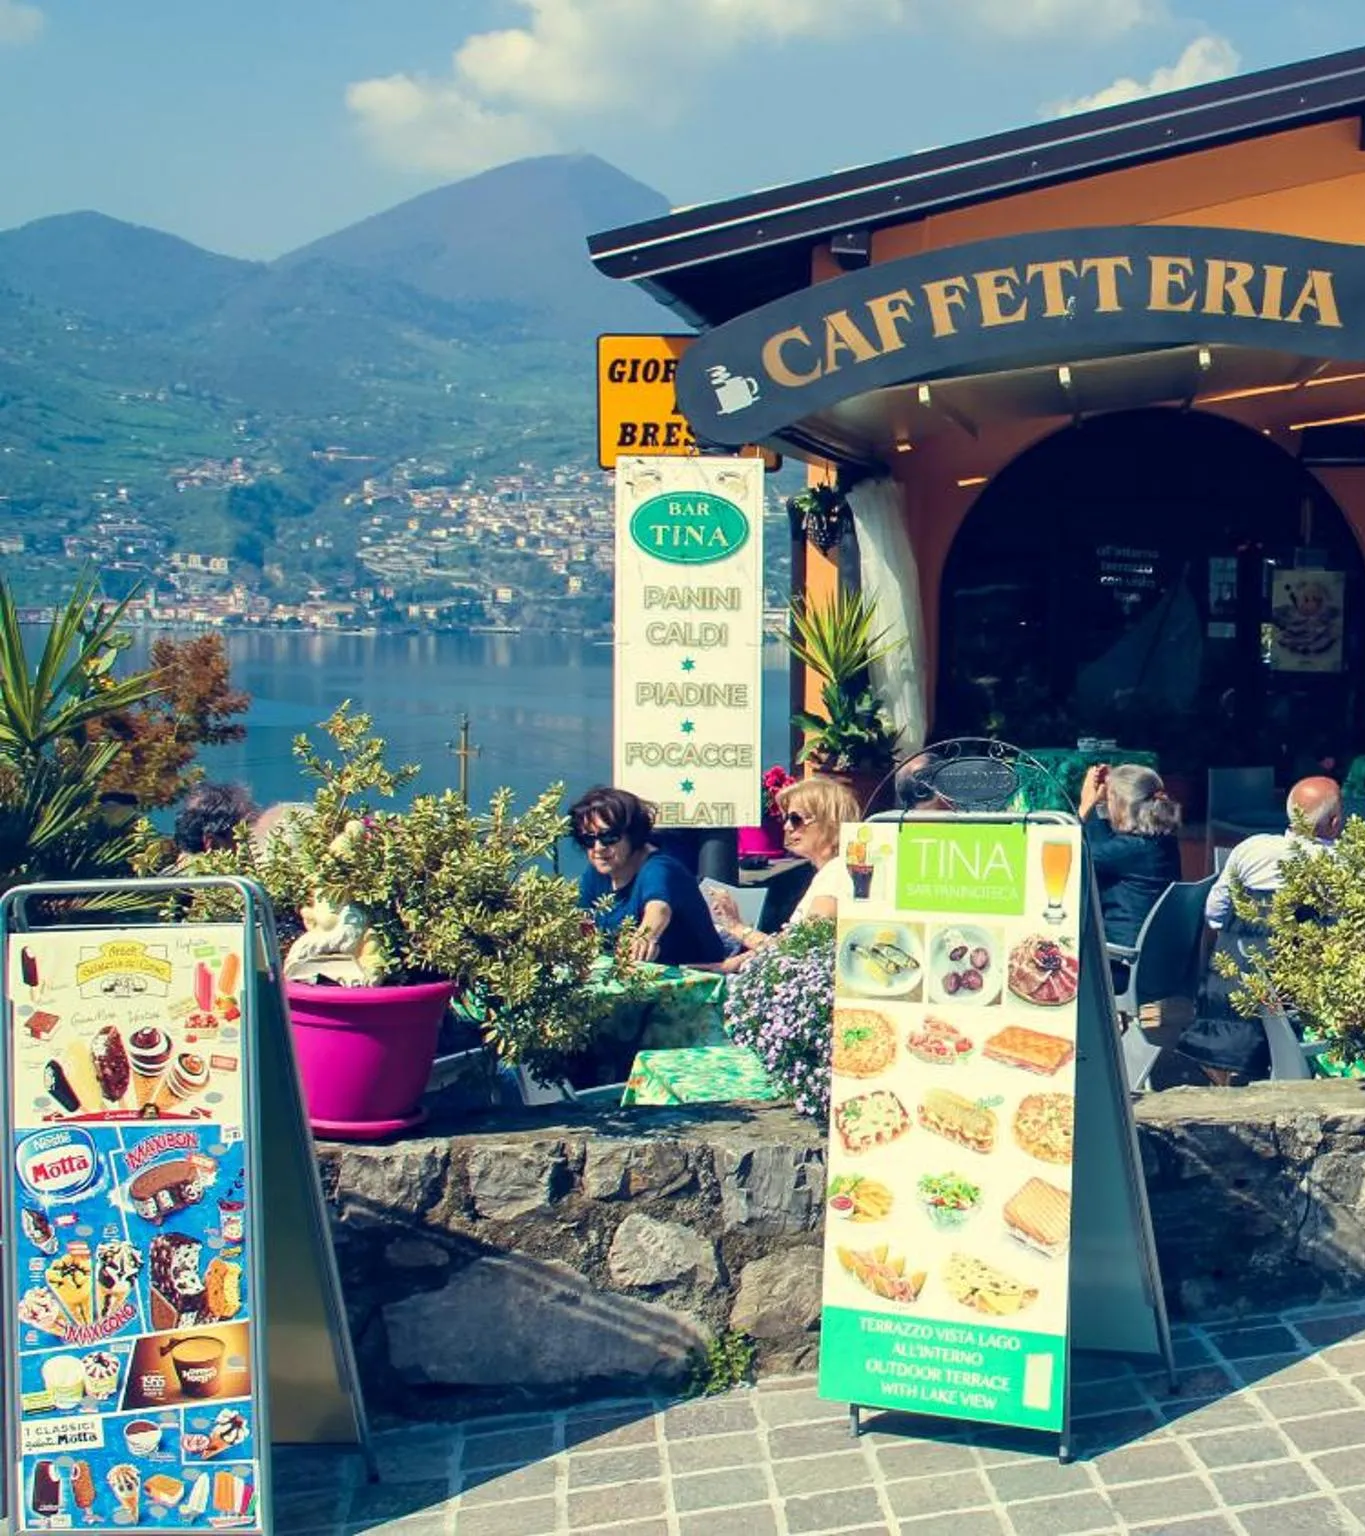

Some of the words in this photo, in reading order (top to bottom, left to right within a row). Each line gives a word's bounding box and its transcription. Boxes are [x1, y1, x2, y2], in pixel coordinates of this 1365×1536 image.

[761, 255, 1344, 387] CAFFETTERIA
[668, 501, 711, 516] BAR
[649, 523, 729, 548] TINA
[643, 585, 741, 612] PANINI
[646, 621, 728, 648] CALDI
[635, 682, 748, 707] PIADINE
[625, 742, 753, 768] FOCACCE
[656, 801, 736, 825] ELATI
[910, 838, 1015, 882] TINA
[125, 1131, 198, 1169] MAXIBON
[32, 1155, 90, 1183] Motta
[860, 1317, 933, 1340] TERRAZZO
[935, 1325, 975, 1345] VISTA
[977, 1331, 1022, 1351] LAGO
[893, 1343, 984, 1366] ALL'INTERNO
[865, 1359, 942, 1382] OUTDOOR
[945, 1370, 1011, 1392] TERRACE
[880, 1380, 918, 1398] WITH
[920, 1386, 955, 1405] LAKE
[960, 1391, 998, 1409] VIEW
[58, 1431, 99, 1445] Motta
